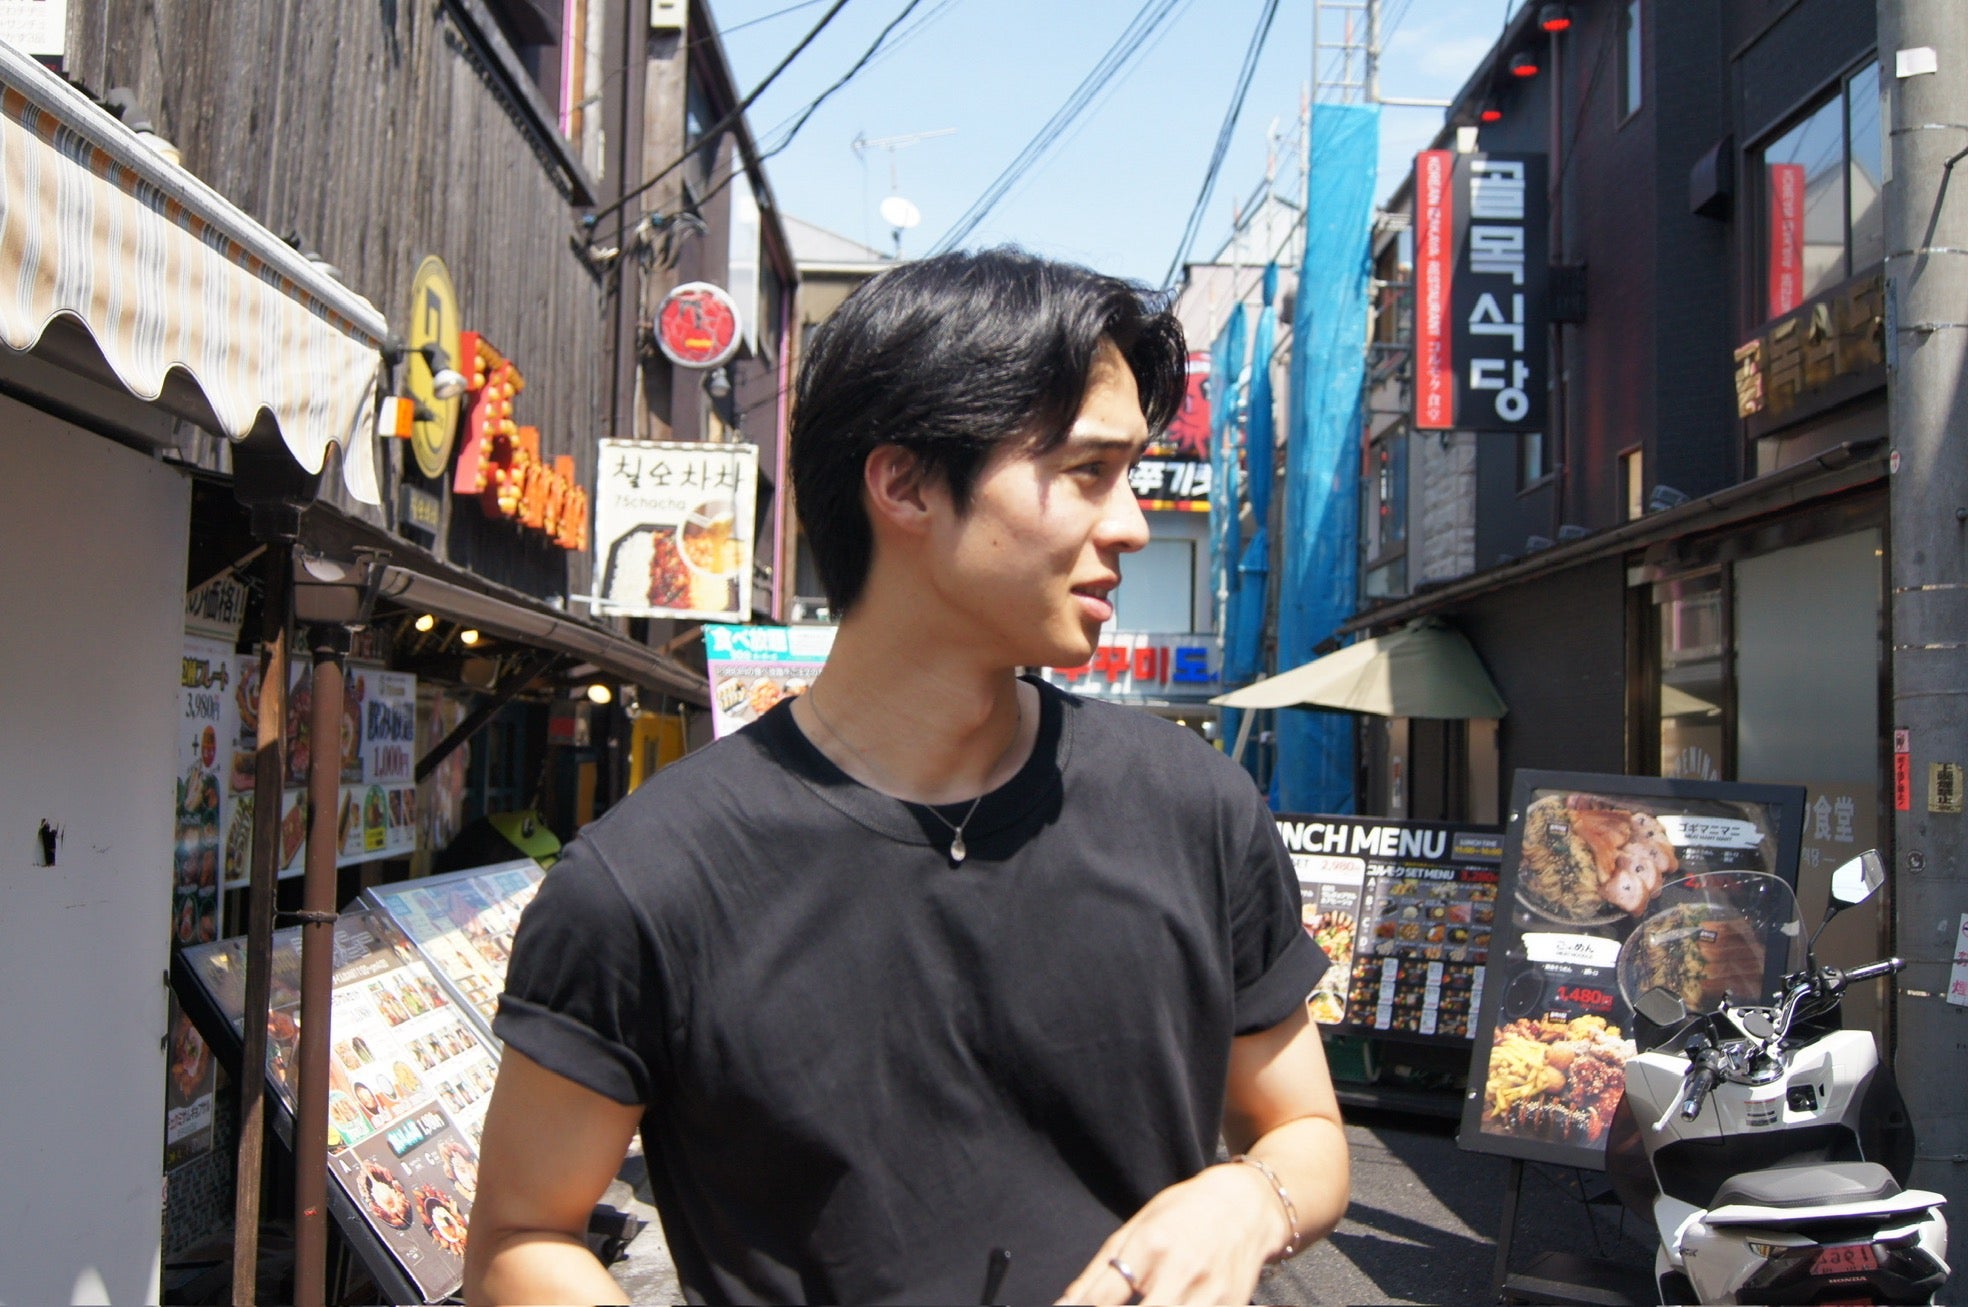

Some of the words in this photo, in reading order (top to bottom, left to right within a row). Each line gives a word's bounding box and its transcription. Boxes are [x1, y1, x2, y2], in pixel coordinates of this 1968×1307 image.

[1468, 160, 1530, 422] 골목식당
[613, 454, 745, 491] 칠오차차
[1276, 820, 1348, 854] NCH
[1351, 823, 1447, 858] MENU
[1424, 868, 1455, 880] MENU
[1829, 1275, 1868, 1284] HONDA
